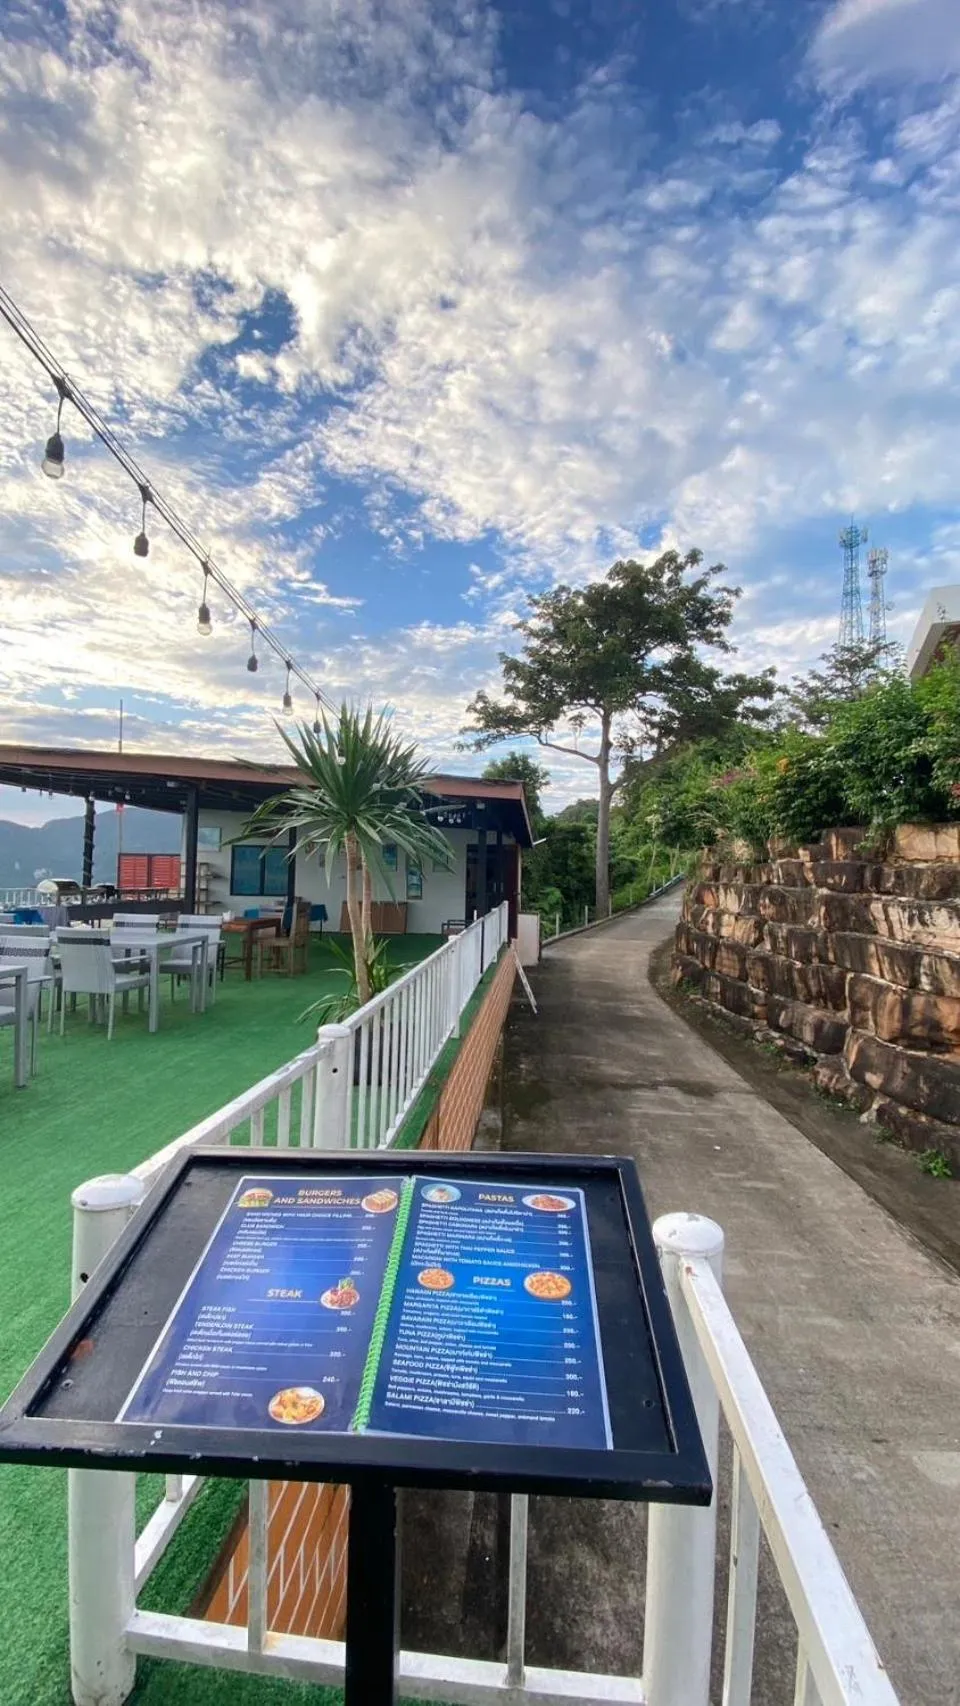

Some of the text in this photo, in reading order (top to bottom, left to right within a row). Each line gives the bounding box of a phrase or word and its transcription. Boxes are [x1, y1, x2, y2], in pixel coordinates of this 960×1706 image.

[296, 1197, 361, 1205] SANDWICHES
[478, 1193, 515, 1203] PASTAS
[473, 1276, 511, 1286] PIZZAS
[267, 1288, 302, 1298] STEAK
[395, 1343, 430, 1352] MOUNTAIN
[392, 1359, 424, 1368] SEAFOOD
[389, 1375, 415, 1384] VEGGIE
[415, 1378, 435, 1386] PIZZA
[386, 1391, 413, 1400] SALAMI
[413, 1394, 434, 1403] PIZZA
